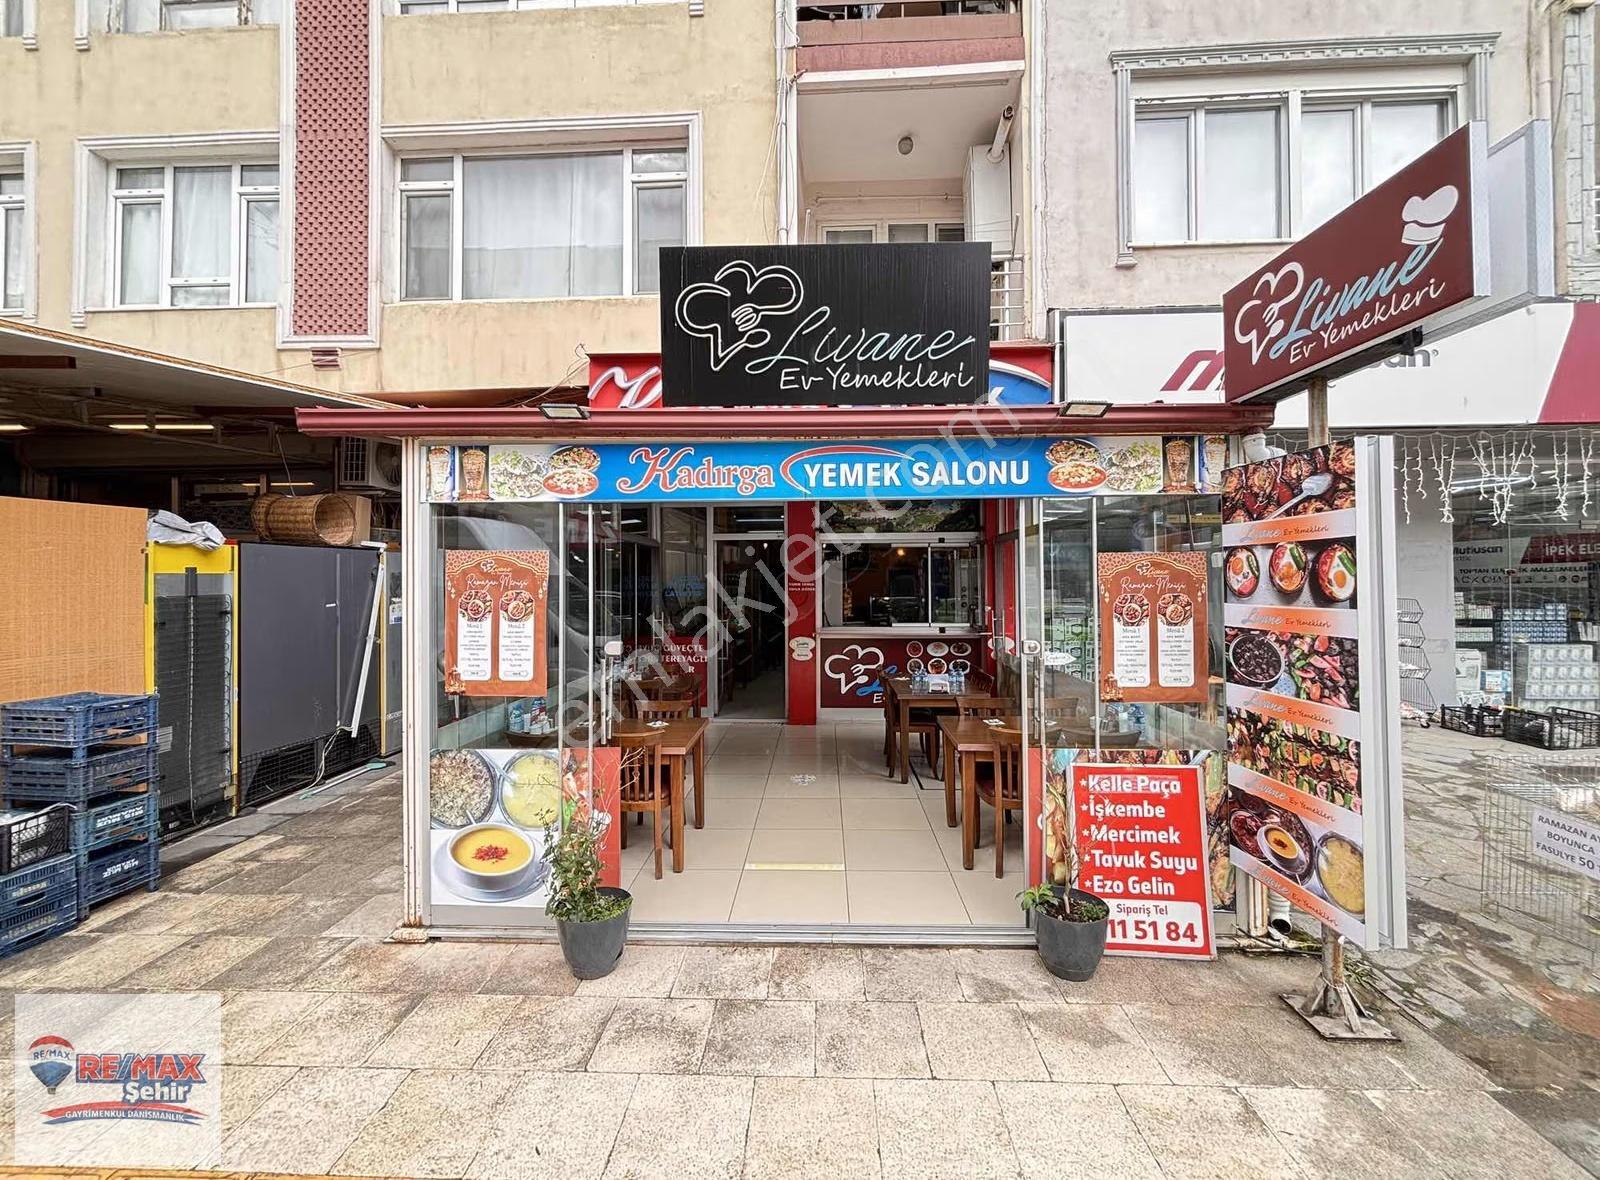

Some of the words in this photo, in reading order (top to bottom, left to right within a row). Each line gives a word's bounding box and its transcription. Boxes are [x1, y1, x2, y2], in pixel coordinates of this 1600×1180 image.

[1271, 237, 1443, 360] Livane
[1289, 338, 1317, 364] Ev
[1320, 278, 1445, 349] Yemekleri
[745, 306, 975, 375] Livane
[780, 367, 822, 390] Ev
[828, 361, 974, 391] Yemekleri
[616, 446, 776, 495] Kadırga
[803, 462, 902, 487] YEMEK
[911, 460, 1029, 485] SALONU
[1545, 543, 1575, 556] İPEK
[873, 693, 884, 703] E
[1088, 775, 1134, 793] Kelle
[1137, 776, 1182, 800] Paça
[1089, 795, 1166, 821] İşkembe
[1090, 824, 1180, 844] Mercimek
[1538, 815, 1588, 838] RAMAZAN
[1536, 841, 1576, 863] FASULYE
[1579, 856, 1595, 870] 50
[1547, 831, 1595, 855] BOYUNCA
[1091, 849, 1146, 869] Tavuk
[1149, 851, 1198, 875] Suyu
[1092, 875, 1124, 894] Ezo
[1127, 875, 1175, 895] Gelin
[1116, 903, 1151, 916] Sipariş
[1153, 905, 1168, 915] Tel
[1134, 920, 1159, 940] 51
[1165, 922, 1198, 943] 84
